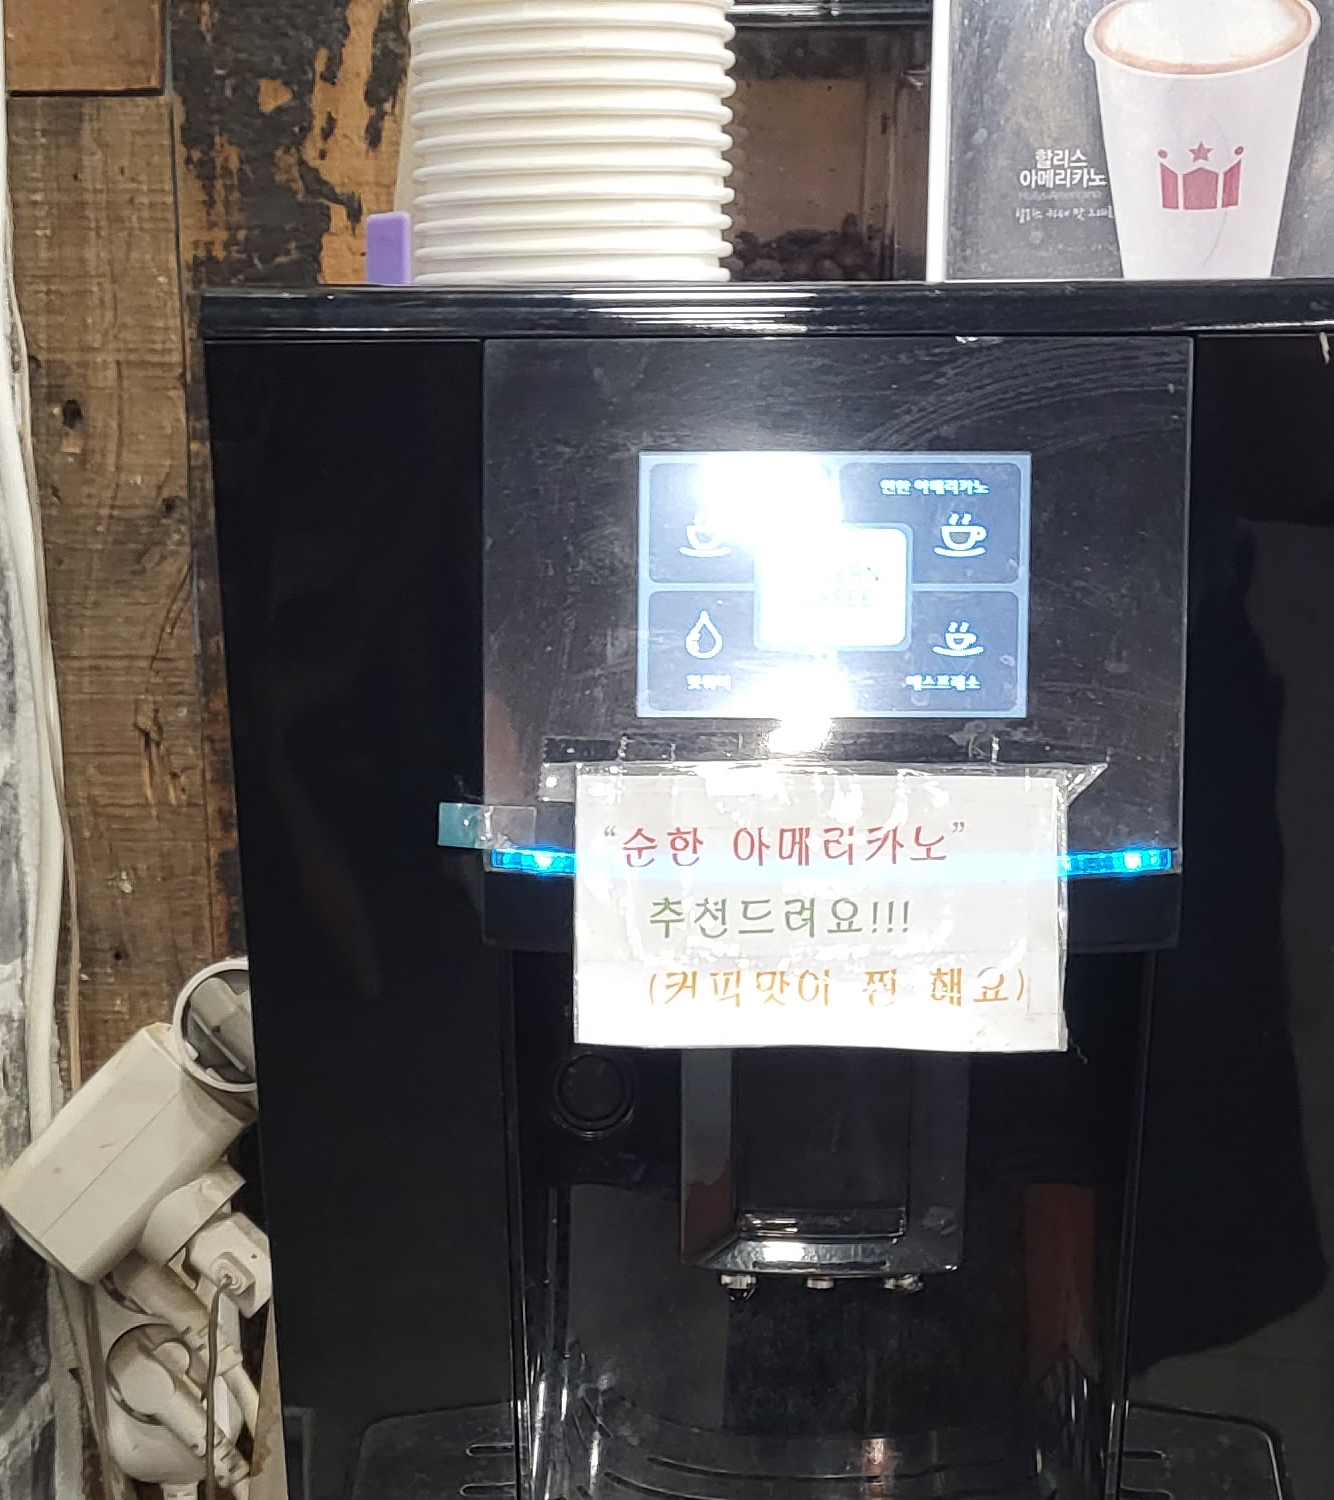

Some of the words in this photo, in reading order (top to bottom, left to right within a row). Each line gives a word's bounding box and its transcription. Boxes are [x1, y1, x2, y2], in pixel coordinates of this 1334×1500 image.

[1034, 148, 1088, 169] 할리스
[1018, 168, 1108, 189] 아메리카노
[905, 674, 982, 691] 에스프레소
[648, 895, 911, 939] 추천드려요!!!
